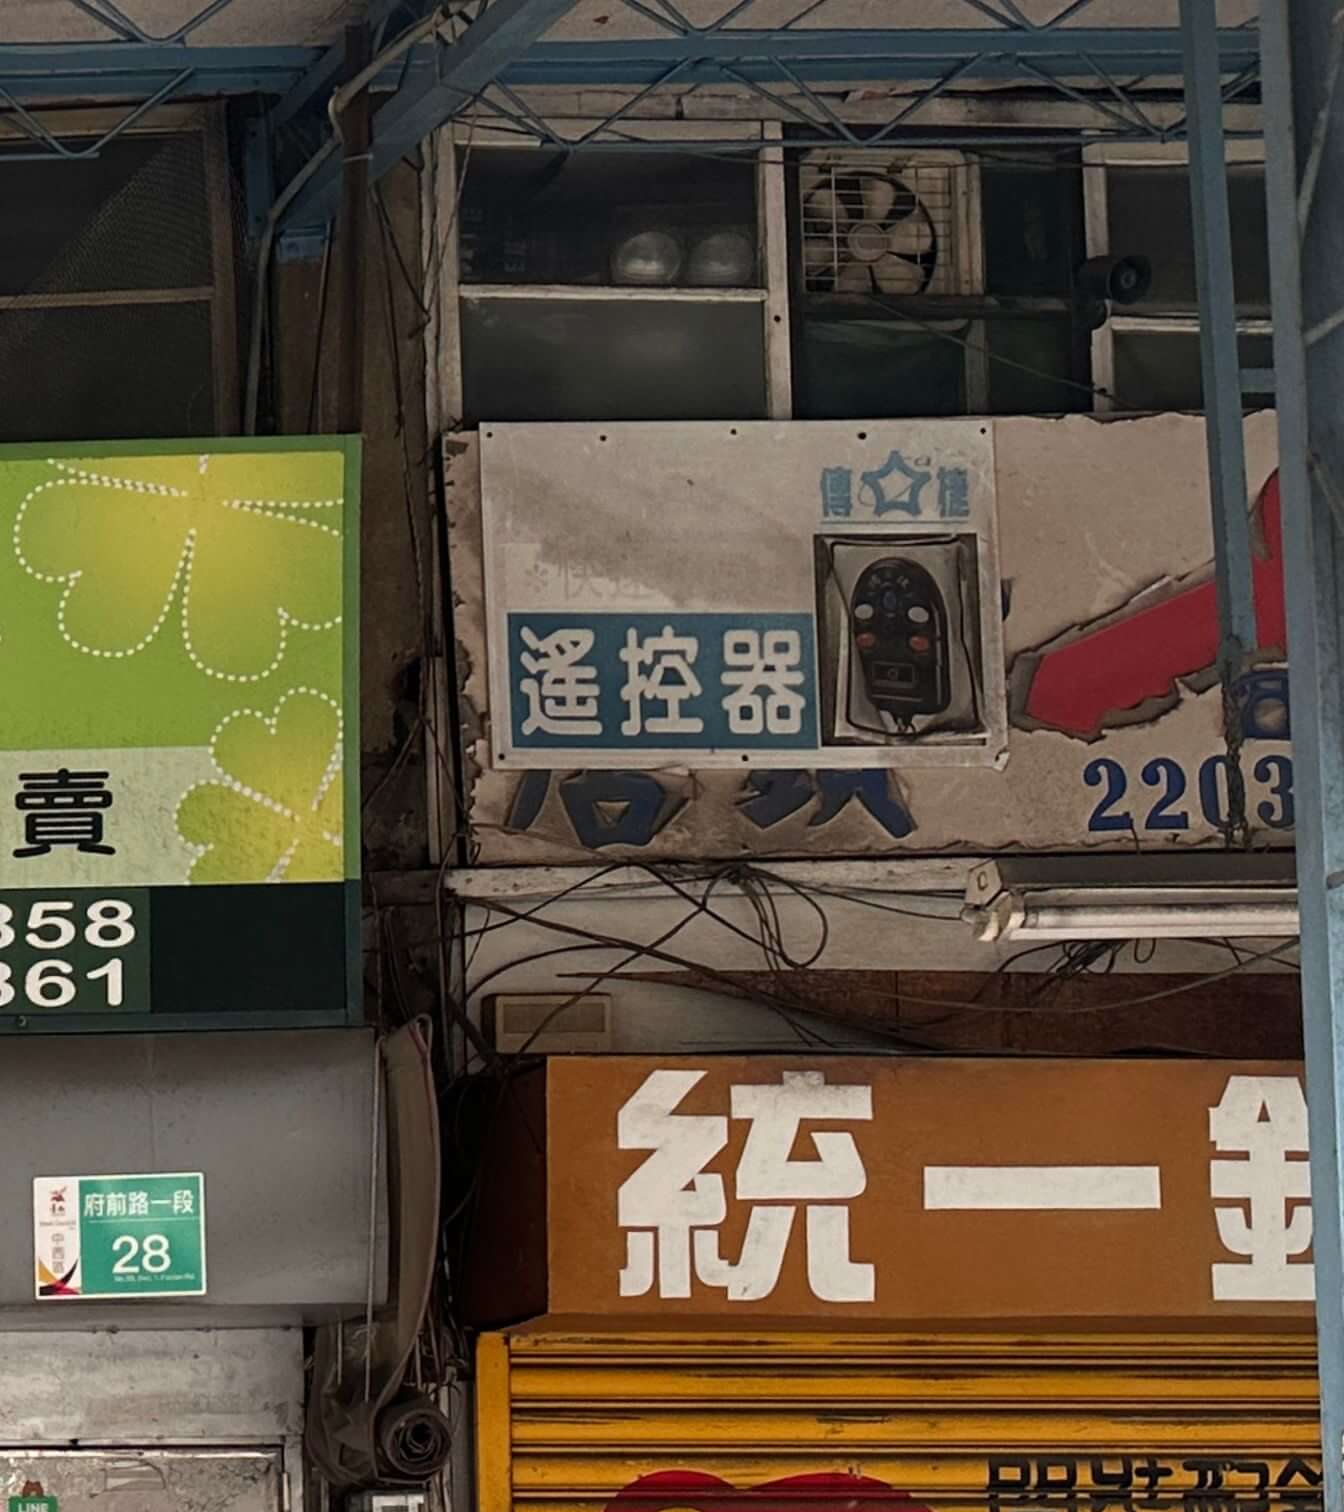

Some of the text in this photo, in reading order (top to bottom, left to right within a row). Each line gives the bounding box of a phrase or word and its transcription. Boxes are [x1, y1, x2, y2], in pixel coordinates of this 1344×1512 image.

[520, 625, 807, 737] 遙控器
[83, 1189, 194, 1217] 府前路一段
[112, 1234, 172, 1274] 28
